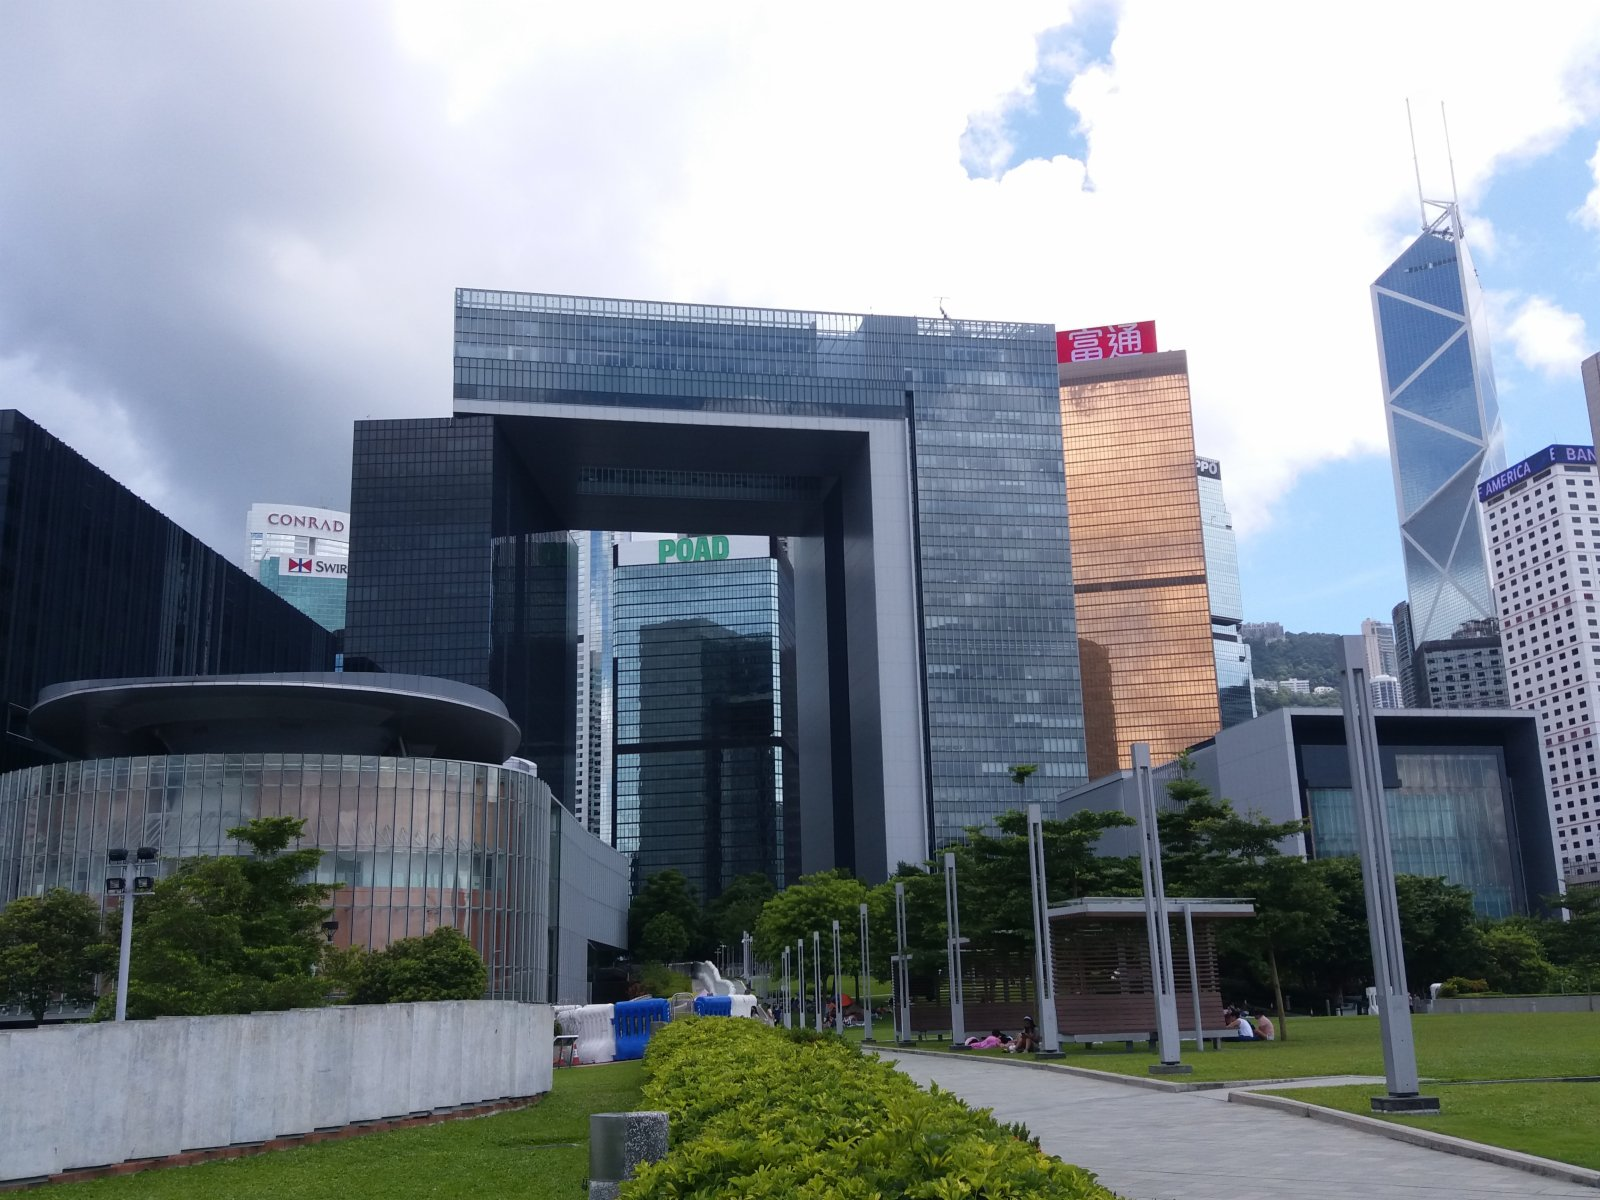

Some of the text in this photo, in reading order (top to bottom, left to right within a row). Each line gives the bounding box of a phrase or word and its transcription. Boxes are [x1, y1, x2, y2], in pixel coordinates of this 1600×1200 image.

[1069, 323, 1143, 362] 富通
[1485, 461, 1531, 496] AMERICA
[267, 513, 345, 533] CONRAD
[658, 535, 730, 564] POAD
